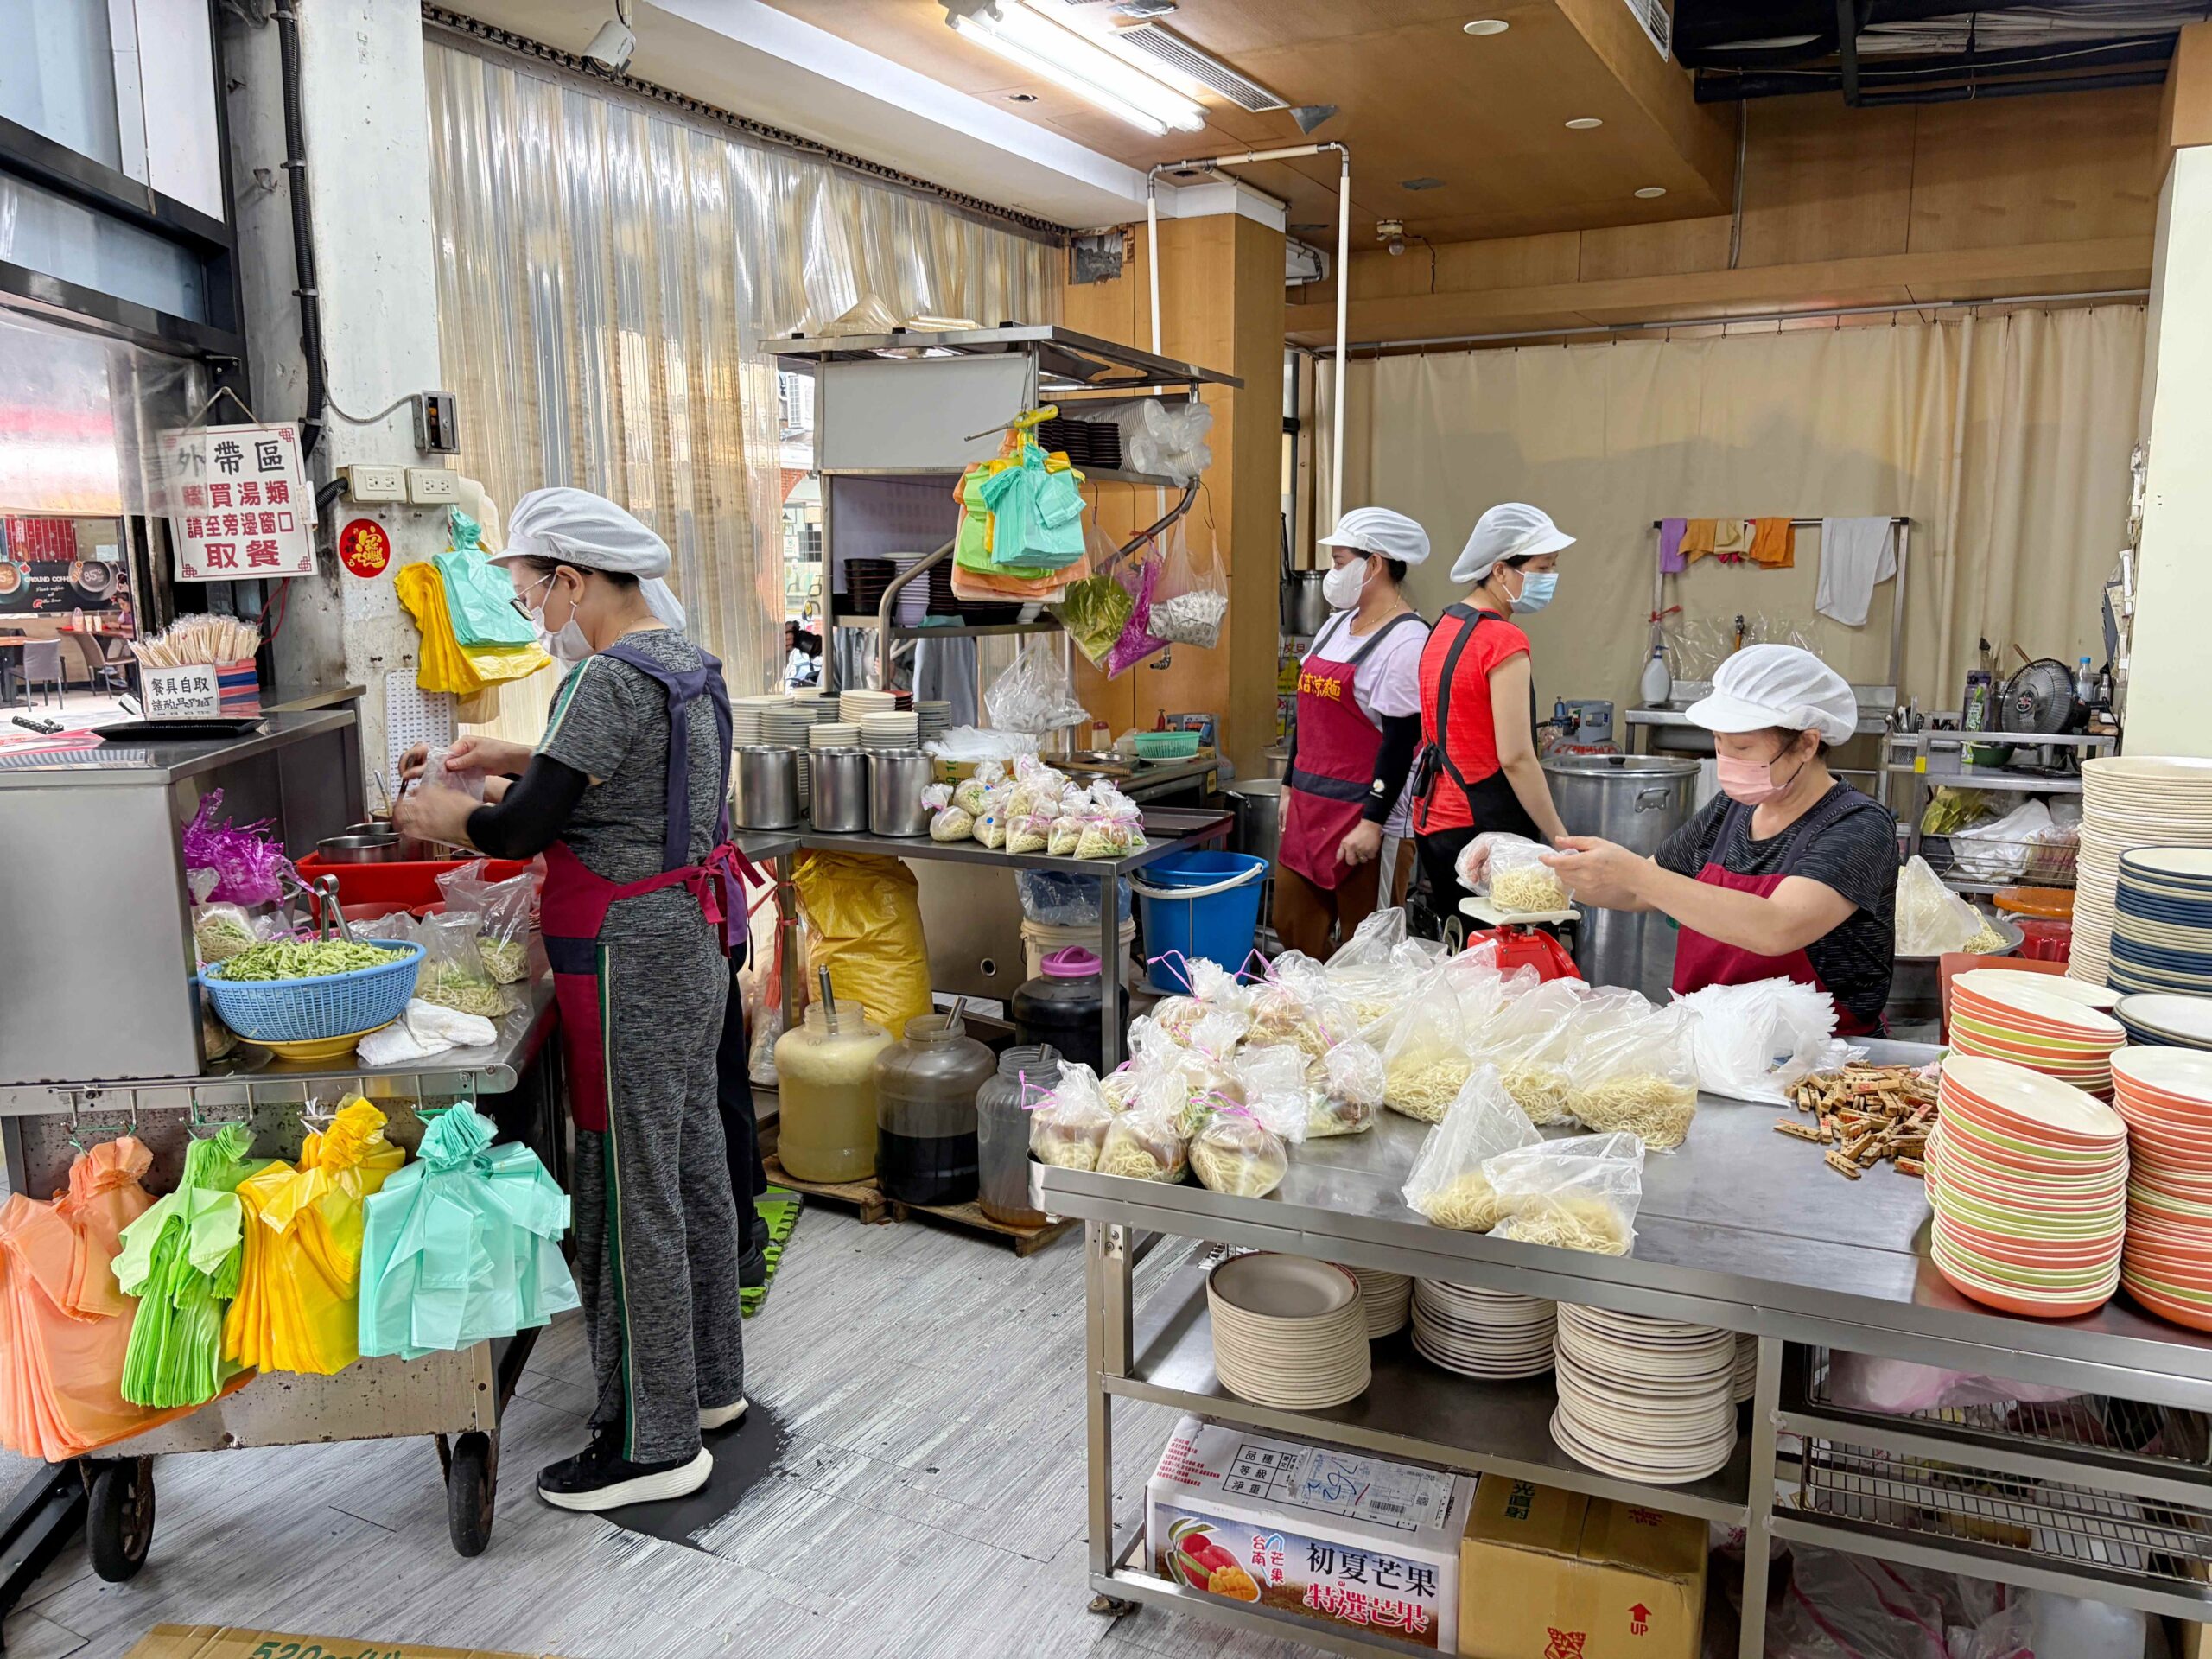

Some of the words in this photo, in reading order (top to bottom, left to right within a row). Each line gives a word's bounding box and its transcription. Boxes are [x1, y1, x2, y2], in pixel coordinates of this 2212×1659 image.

[177, 440, 285, 477] 外帶區
[186, 512, 295, 539] 請至旁邊窗口
[204, 540, 281, 569] 取餐
[151, 677, 210, 696] 餐具自取
[1245, 1450, 1274, 1464] 品種
[1240, 1465, 1267, 1479] 等級
[1231, 1479, 1261, 1494] 淨重
[1252, 1535, 1266, 1567] 台南
[1270, 1551, 1284, 1583] 芒果
[1306, 1542, 1435, 1598] 初夏芒果
[1305, 1580, 1429, 1632] 特選芒果
[1630, 1622, 1649, 1636] UP
